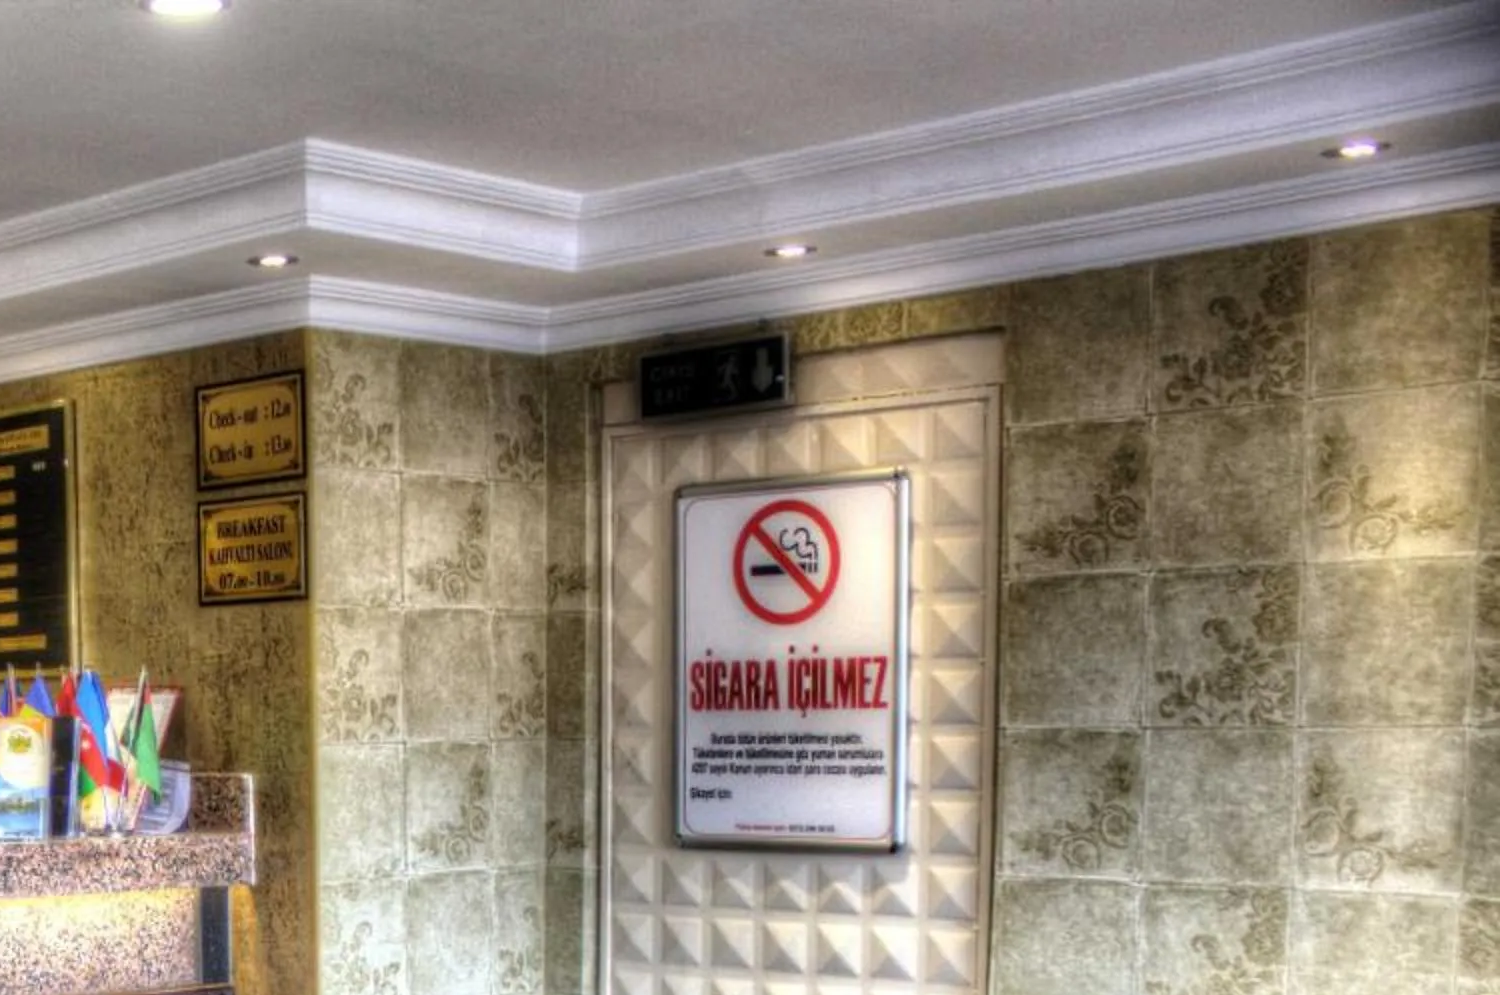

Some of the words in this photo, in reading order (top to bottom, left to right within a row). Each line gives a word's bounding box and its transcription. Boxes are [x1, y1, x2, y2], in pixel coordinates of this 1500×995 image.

[217, 514, 285, 538] BREAKFAST
[690, 649, 780, 711] SİGARA
[787, 645, 889, 718] İÇİLMEZ
